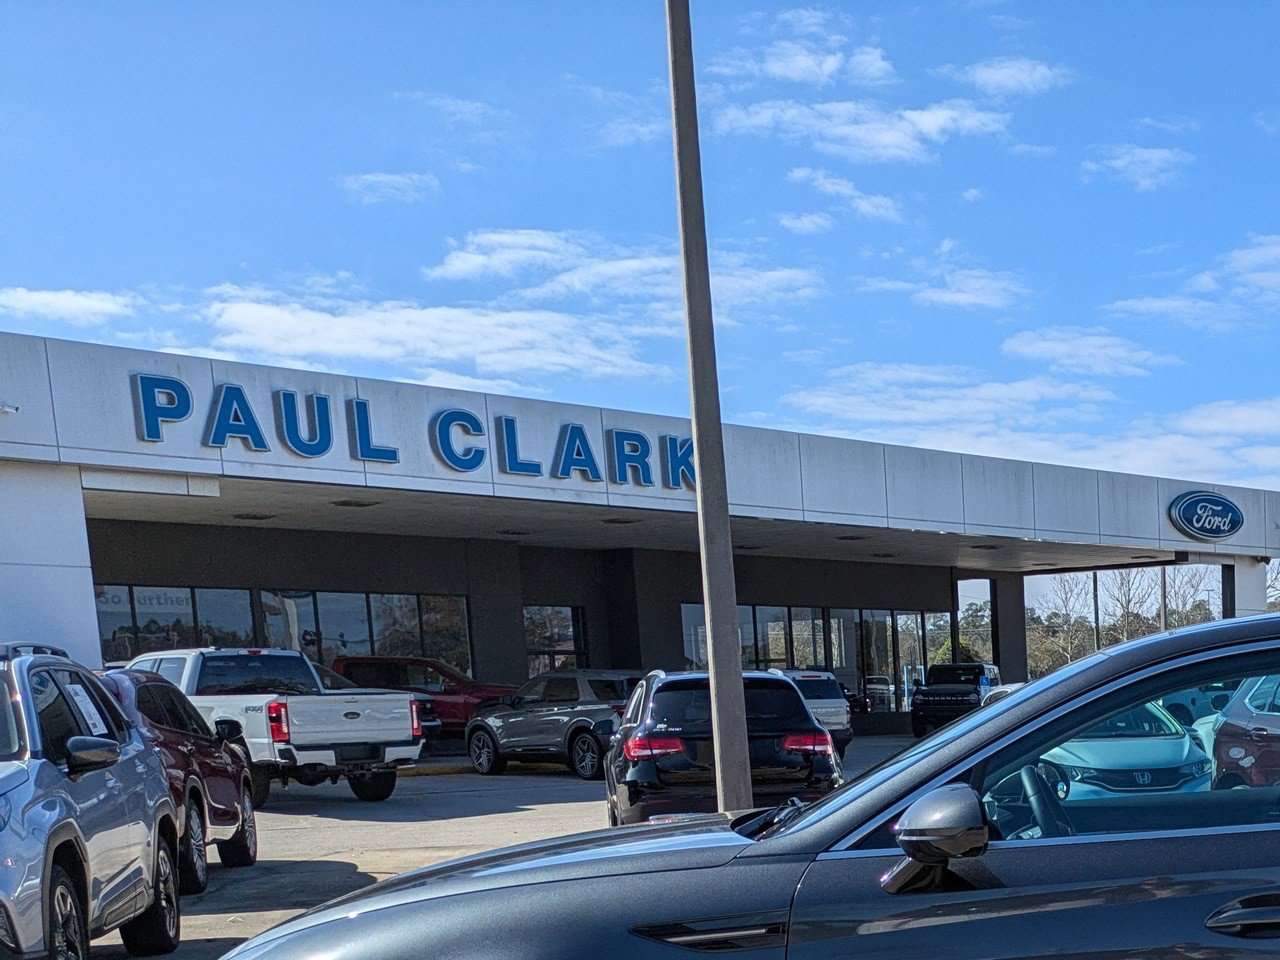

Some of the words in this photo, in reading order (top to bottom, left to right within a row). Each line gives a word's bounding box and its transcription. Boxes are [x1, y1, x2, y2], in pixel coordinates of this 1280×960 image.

[130, 373, 400, 463] PAUL
[428, 409, 697, 490] CLARK
[1193, 503, 1232, 530] Ford
